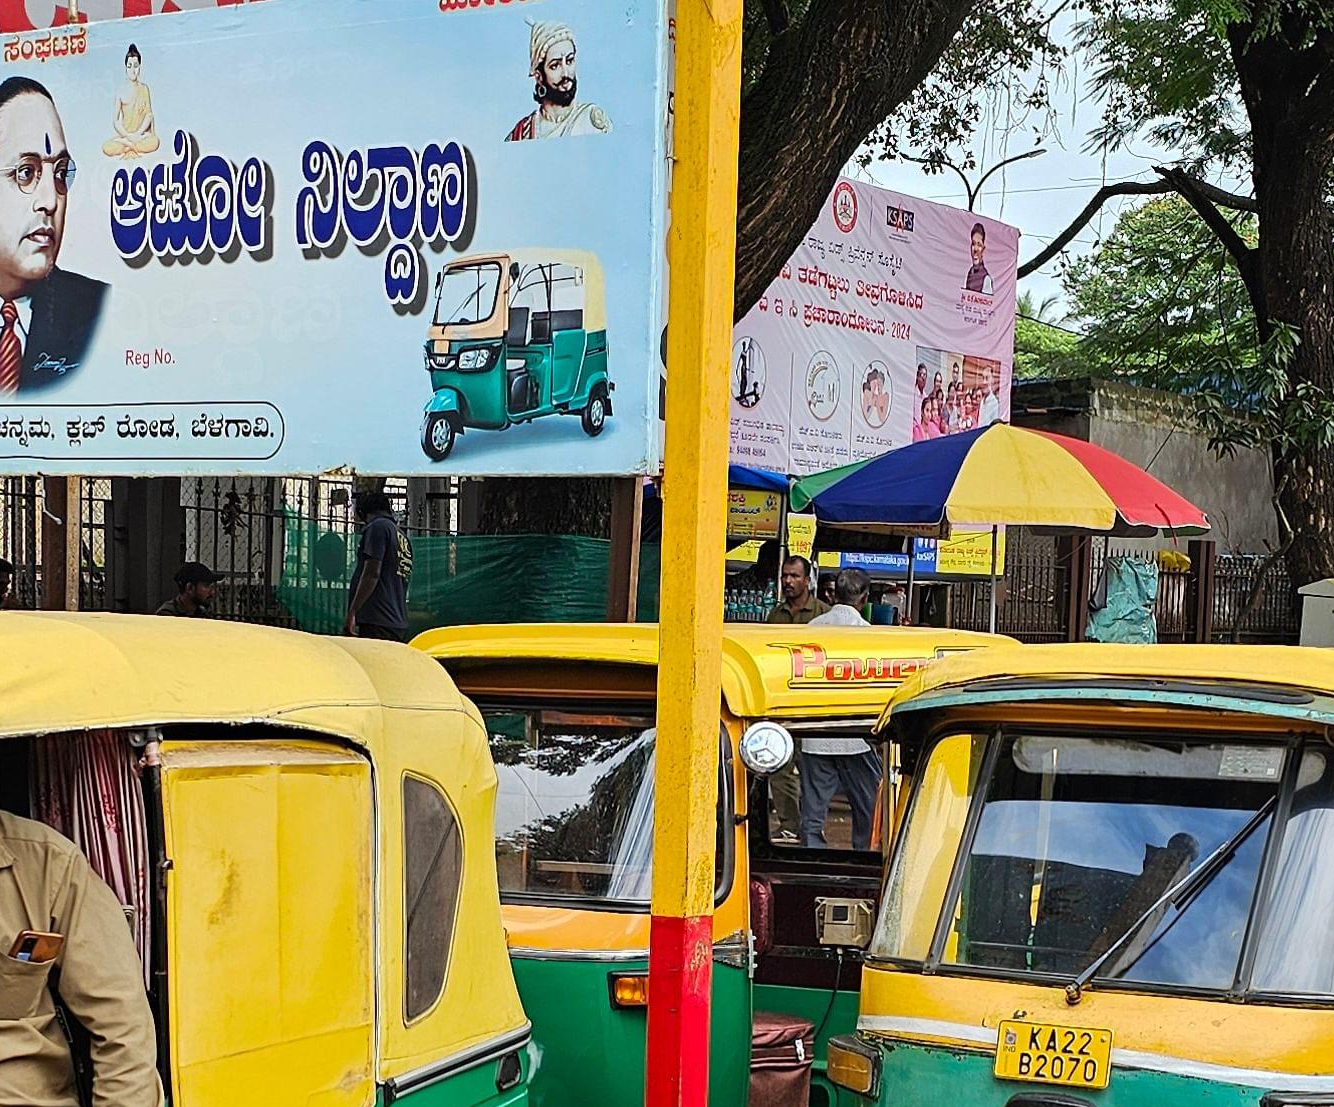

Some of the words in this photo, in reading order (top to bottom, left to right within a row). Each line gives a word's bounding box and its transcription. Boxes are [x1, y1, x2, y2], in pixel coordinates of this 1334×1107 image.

[110, 129, 267, 259] ಆಟೋ
[295, 140, 469, 304] ನಿಲ್ದಾಣ
[887, 203, 915, 232] KSAPS
[891, 321, 911, 341] 2024
[125, 349, 150, 369] Reg
[154, 348, 176, 365] No.
[66, 415, 106, 447] ಕ್ಲಬ್
[191, 411, 275, 440] ಬೆಳಗಾವಿ.
[1028, 1026, 1093, 1056] KA22
[1017, 1052, 1098, 1082] B2070
